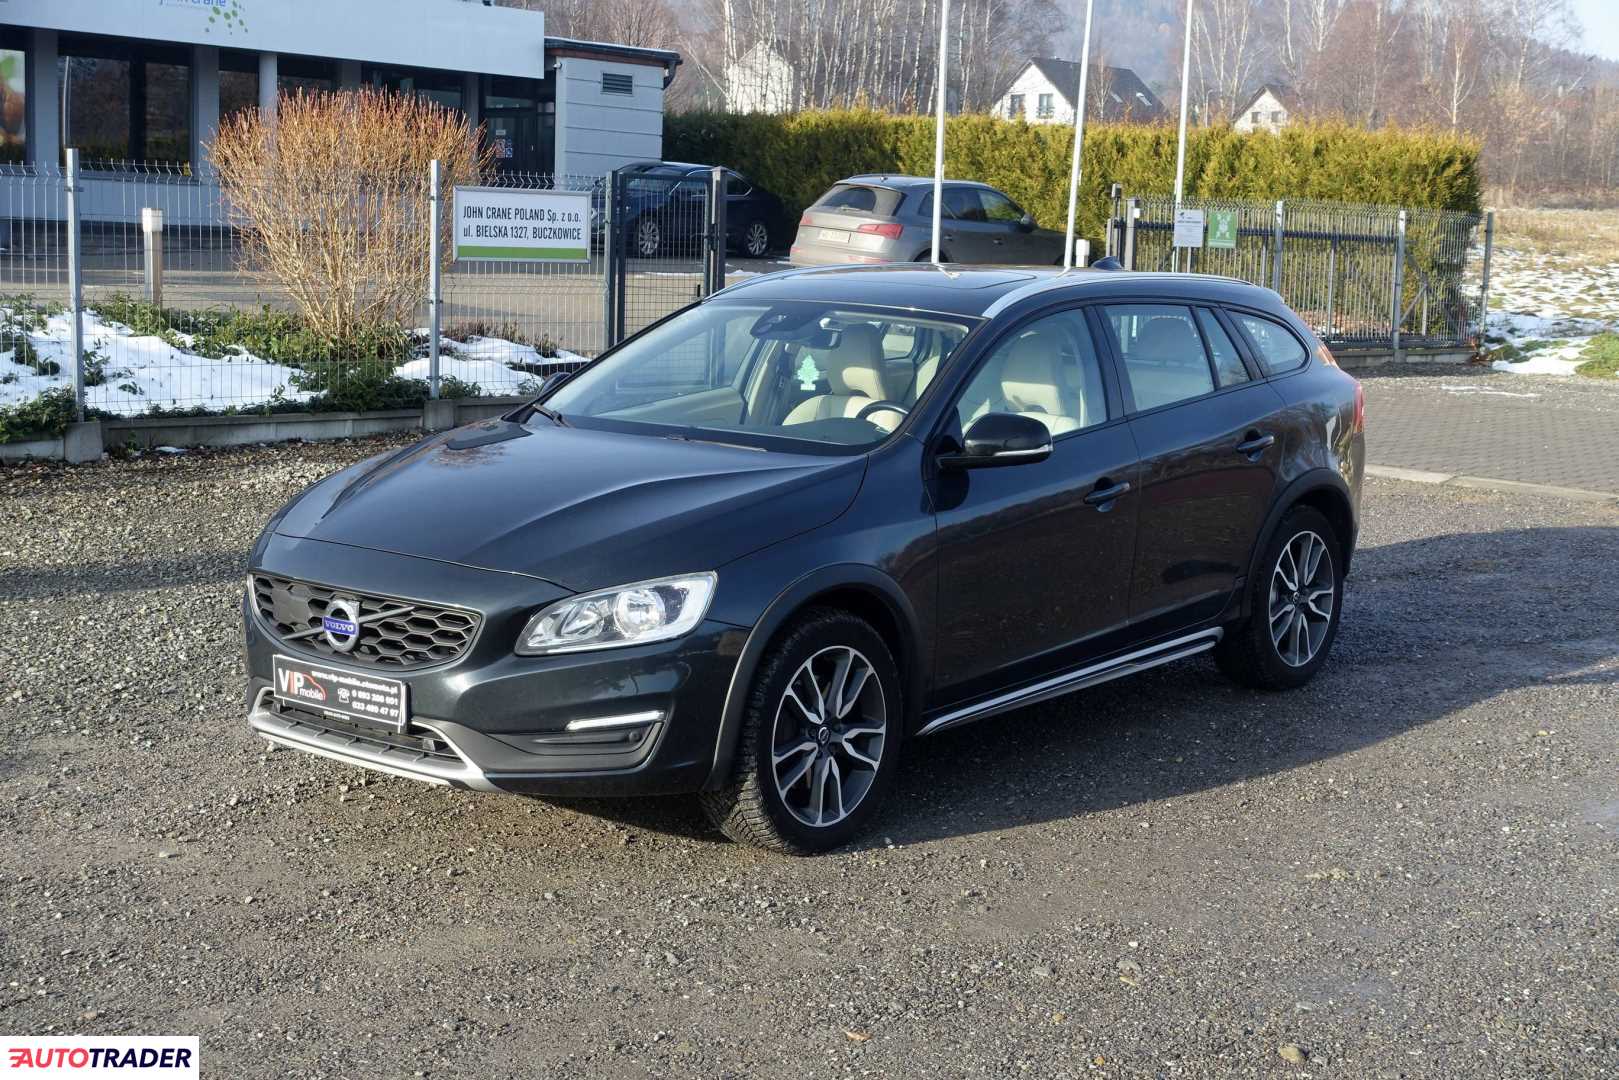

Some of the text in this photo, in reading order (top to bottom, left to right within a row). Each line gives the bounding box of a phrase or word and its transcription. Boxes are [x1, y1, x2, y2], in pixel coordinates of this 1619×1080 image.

[463, 205, 581, 224] JOHN CRANE POLAND Sp. z o.o.
[463, 224, 581, 240] ul. BIELSKA 1327, BUCZKOWICE
[325, 621, 354, 632] VOLVO
[278, 668, 304, 695] VIP
[299, 687, 324, 701] mobile
